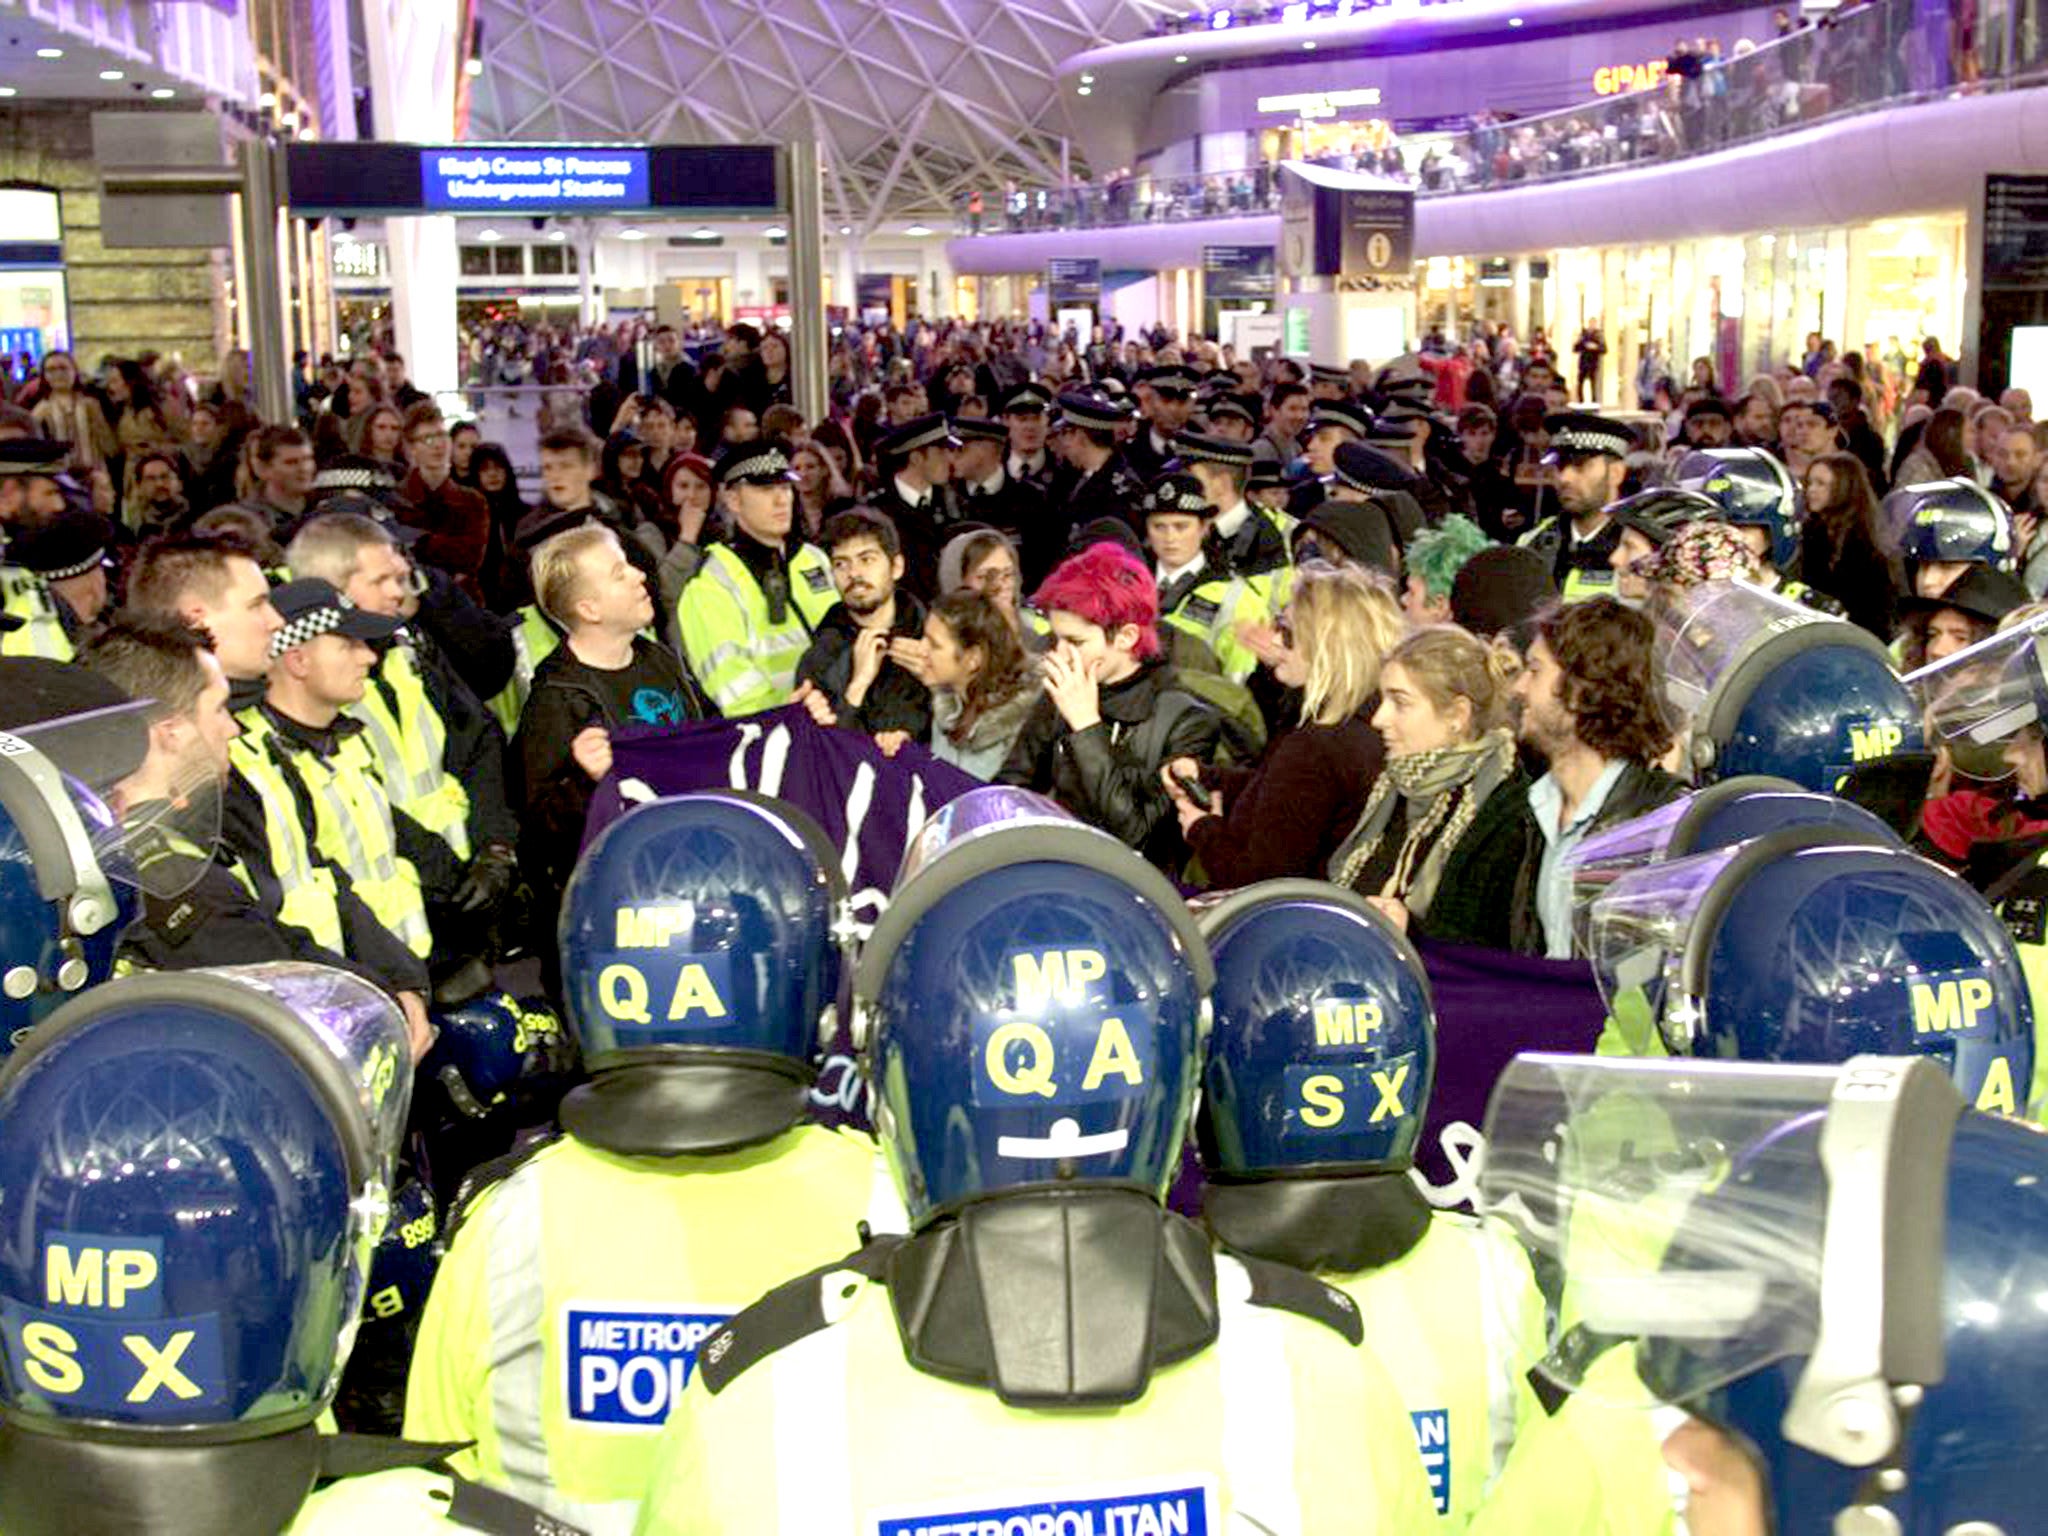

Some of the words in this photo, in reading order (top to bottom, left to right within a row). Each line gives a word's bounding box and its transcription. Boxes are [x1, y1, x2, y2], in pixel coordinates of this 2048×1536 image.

[492, 157, 542, 175] Cross
[543, 157, 564, 175] St
[565, 157, 632, 175] Pancras
[447, 179, 560, 201] Underground
[562, 179, 625, 197] Station
[1851, 725, 1902, 762] MP
[617, 906, 696, 949] MP
[1014, 949, 1106, 1012] MP
[1314, 1004, 1383, 1046] MP
[1912, 978, 1993, 1034] MP
[47, 1244, 158, 1309] MP
[897, 1498, 1188, 1536] OPOLITAN
